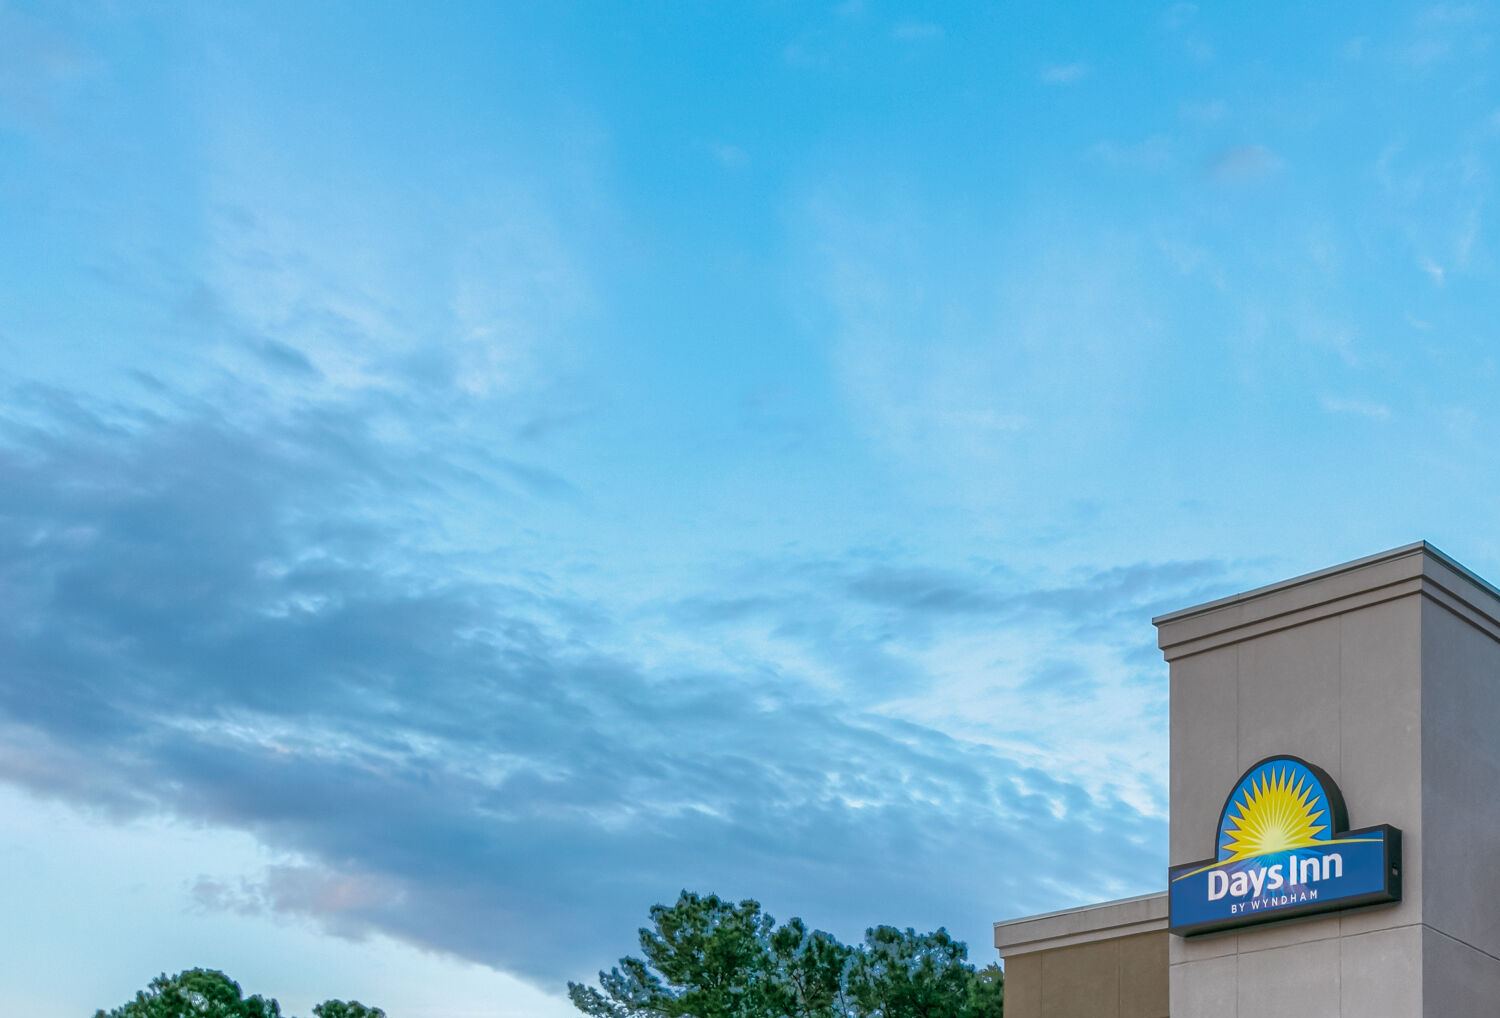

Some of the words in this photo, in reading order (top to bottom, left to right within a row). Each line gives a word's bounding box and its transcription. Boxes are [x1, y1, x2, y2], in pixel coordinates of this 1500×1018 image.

[1208, 863, 1284, 901] Days
[1289, 853, 1343, 886] Inn
[1231, 903, 1245, 914] BY
[1251, 890, 1318, 910] WYNDHAM
